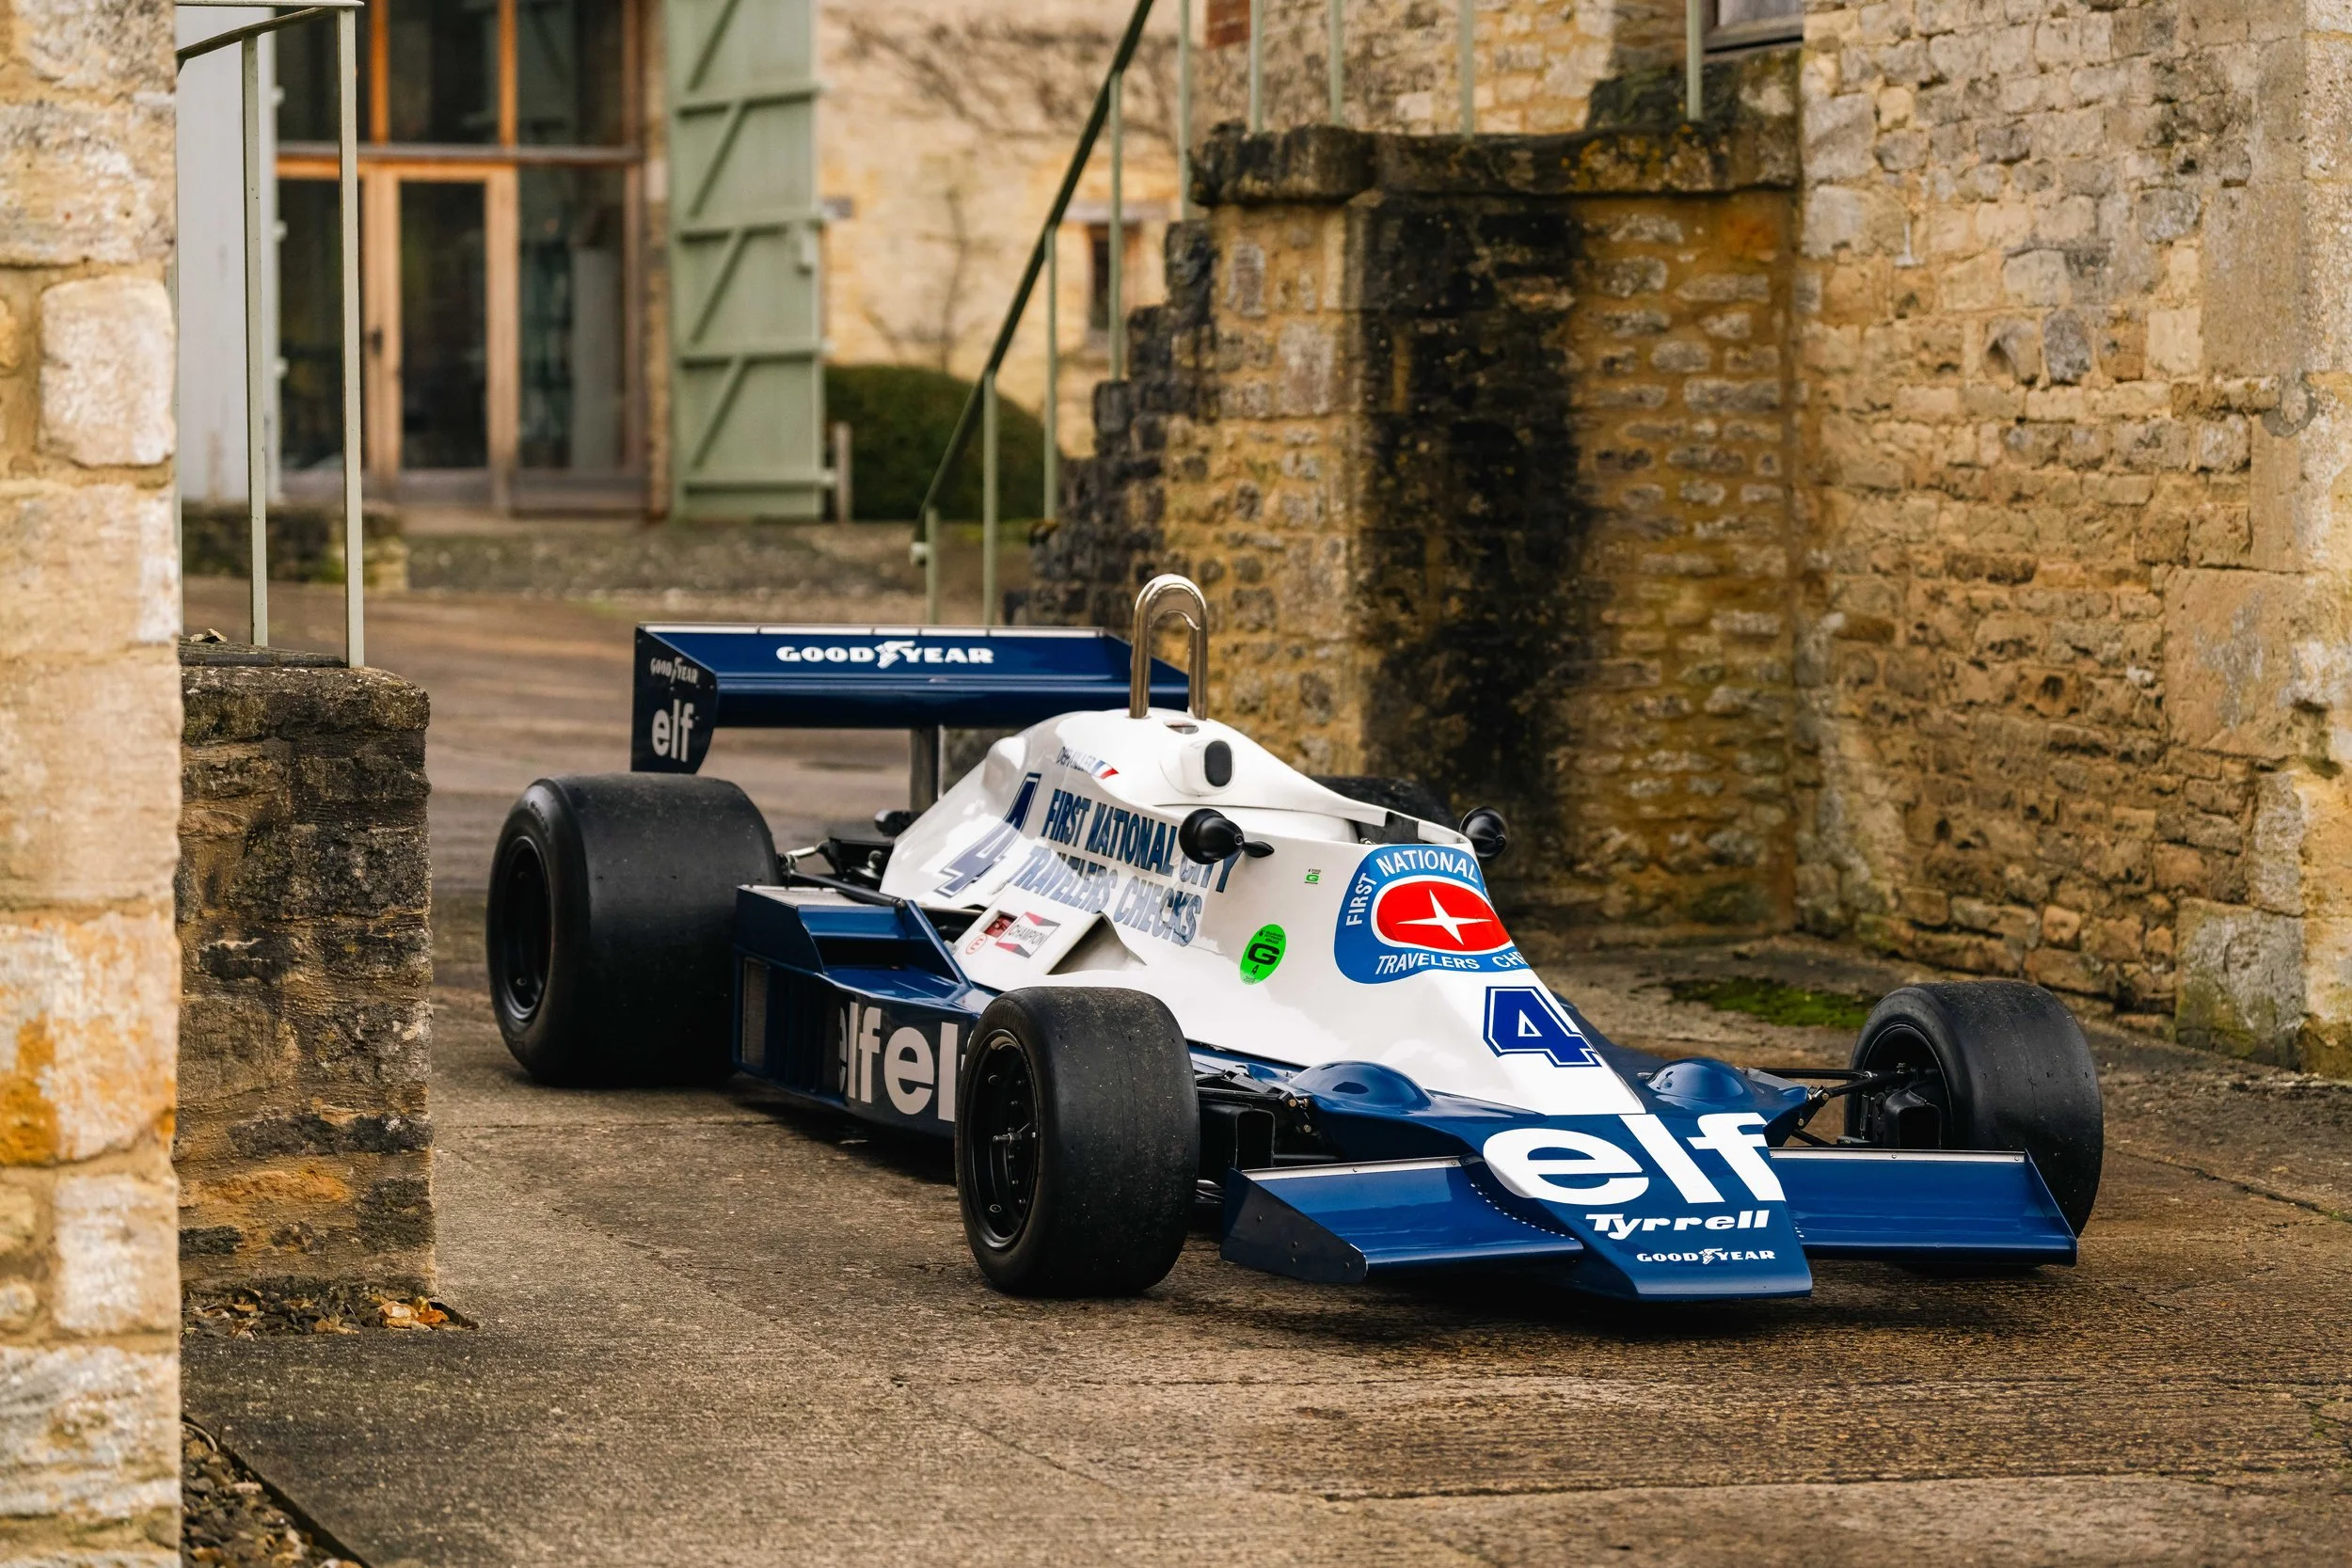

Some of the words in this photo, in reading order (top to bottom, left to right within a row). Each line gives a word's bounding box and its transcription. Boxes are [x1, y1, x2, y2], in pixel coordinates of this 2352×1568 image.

[650, 657, 699, 685] GOODYEAR
[776, 641, 993, 669] GOODYEAR
[651, 699, 694, 763] elf
[933, 772, 1042, 899] 4
[1041, 788, 1092, 843] FIRST
[1084, 800, 1179, 877] NATIONAL
[1006, 846, 1119, 914] TRAVELERS
[1113, 876, 1202, 947] CHECKS
[1345, 873, 1378, 927] FIRST
[1375, 849, 1479, 883] NATIONAL
[1008, 924, 1047, 946] CHAMPION
[1248, 942, 1280, 966] G
[1375, 952, 1481, 975] TRAVELERS
[1483, 986, 1602, 1068] 4
[883, 1022, 975, 1122] el
[1483, 1112, 1788, 1206] elf
[1585, 1210, 1770, 1241] Tyrrell
[1636, 1248, 1776, 1265] GOODYEAR
